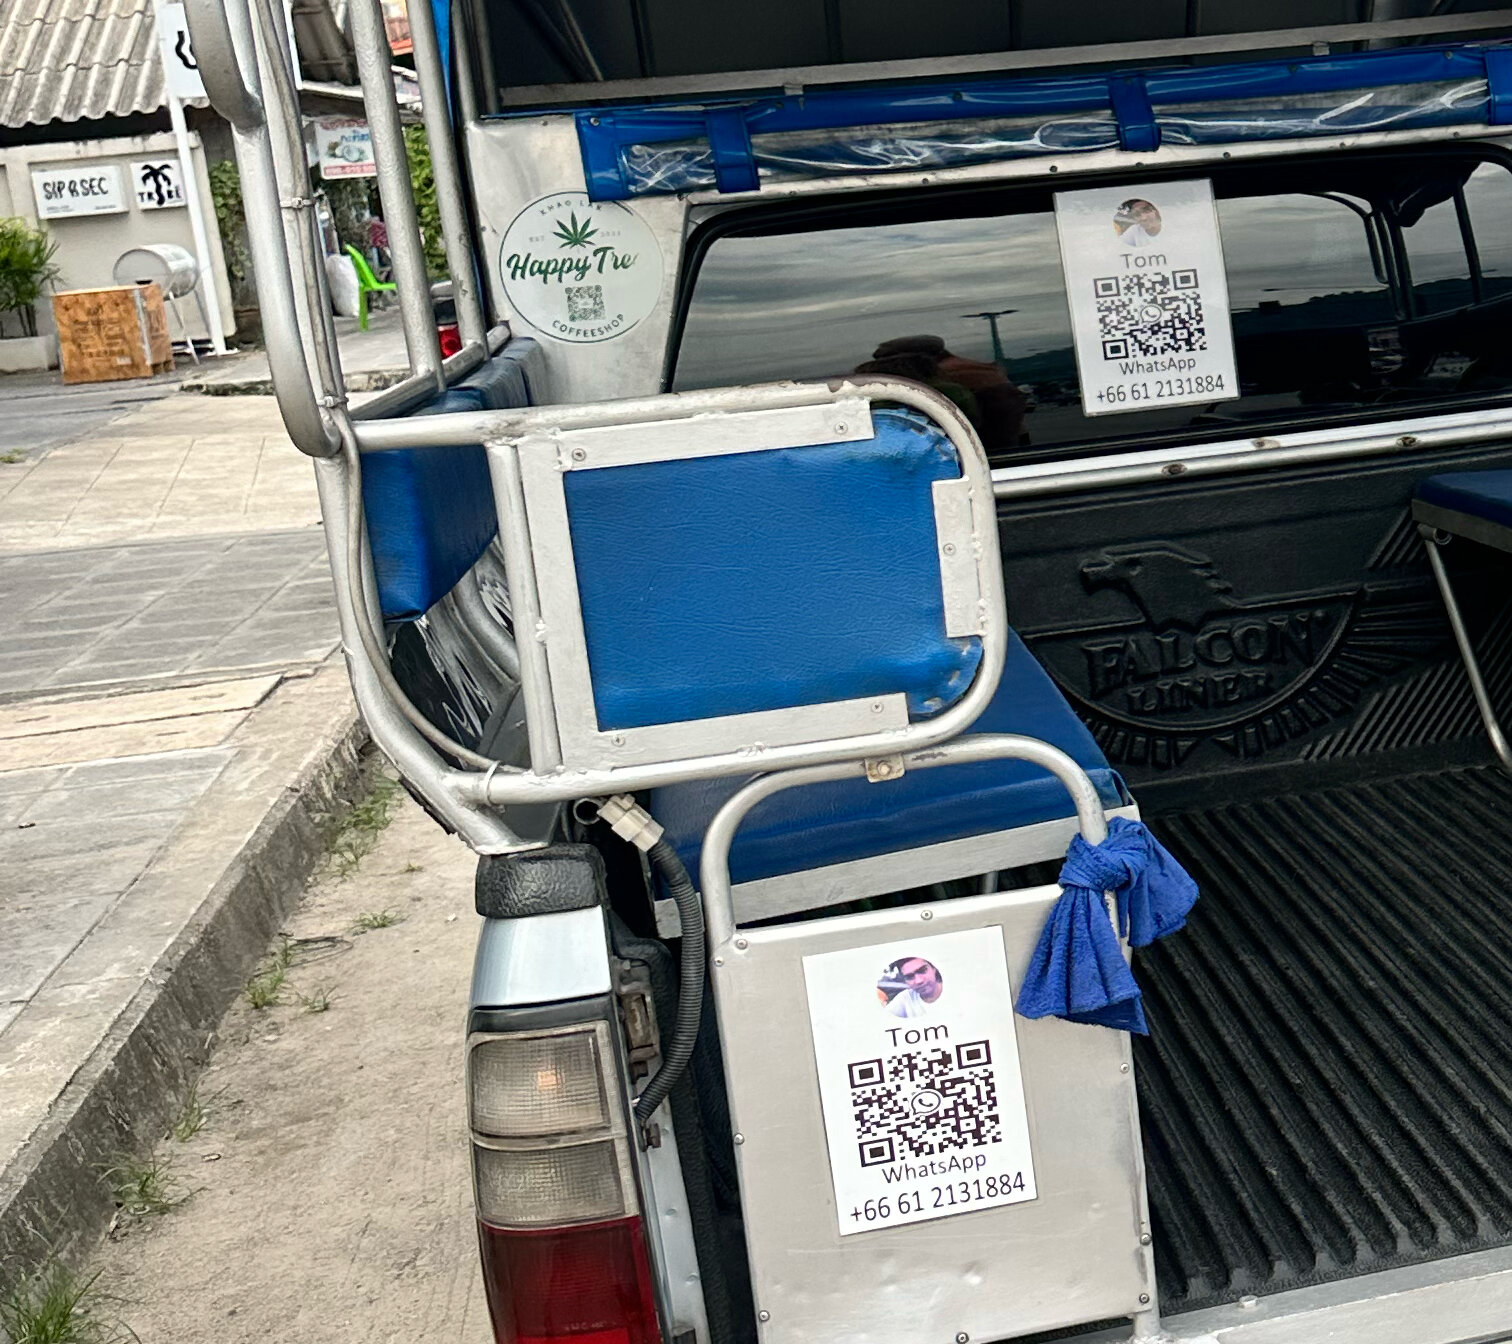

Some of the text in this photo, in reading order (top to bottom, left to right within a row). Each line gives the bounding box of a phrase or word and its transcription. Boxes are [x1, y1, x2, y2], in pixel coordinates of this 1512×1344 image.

[43, 179, 66, 200] SIP
[80, 176, 109, 197] SEC
[539, 199, 571, 216] KHAO
[506, 252, 592, 285] Happy
[1120, 253, 1167, 269] Tom
[552, 312, 625, 338] COFFEESHOP
[1118, 357, 1196, 376] WhatsApp
[1096, 374, 1225, 404] +66 61 2131884
[1081, 612, 1315, 697] FALCON
[1127, 669, 1273, 714] LINER
[885, 1023, 949, 1048] Tom
[881, 1151, 987, 1185] WhatsApp
[850, 1171, 1026, 1223] +66 61 2131884
